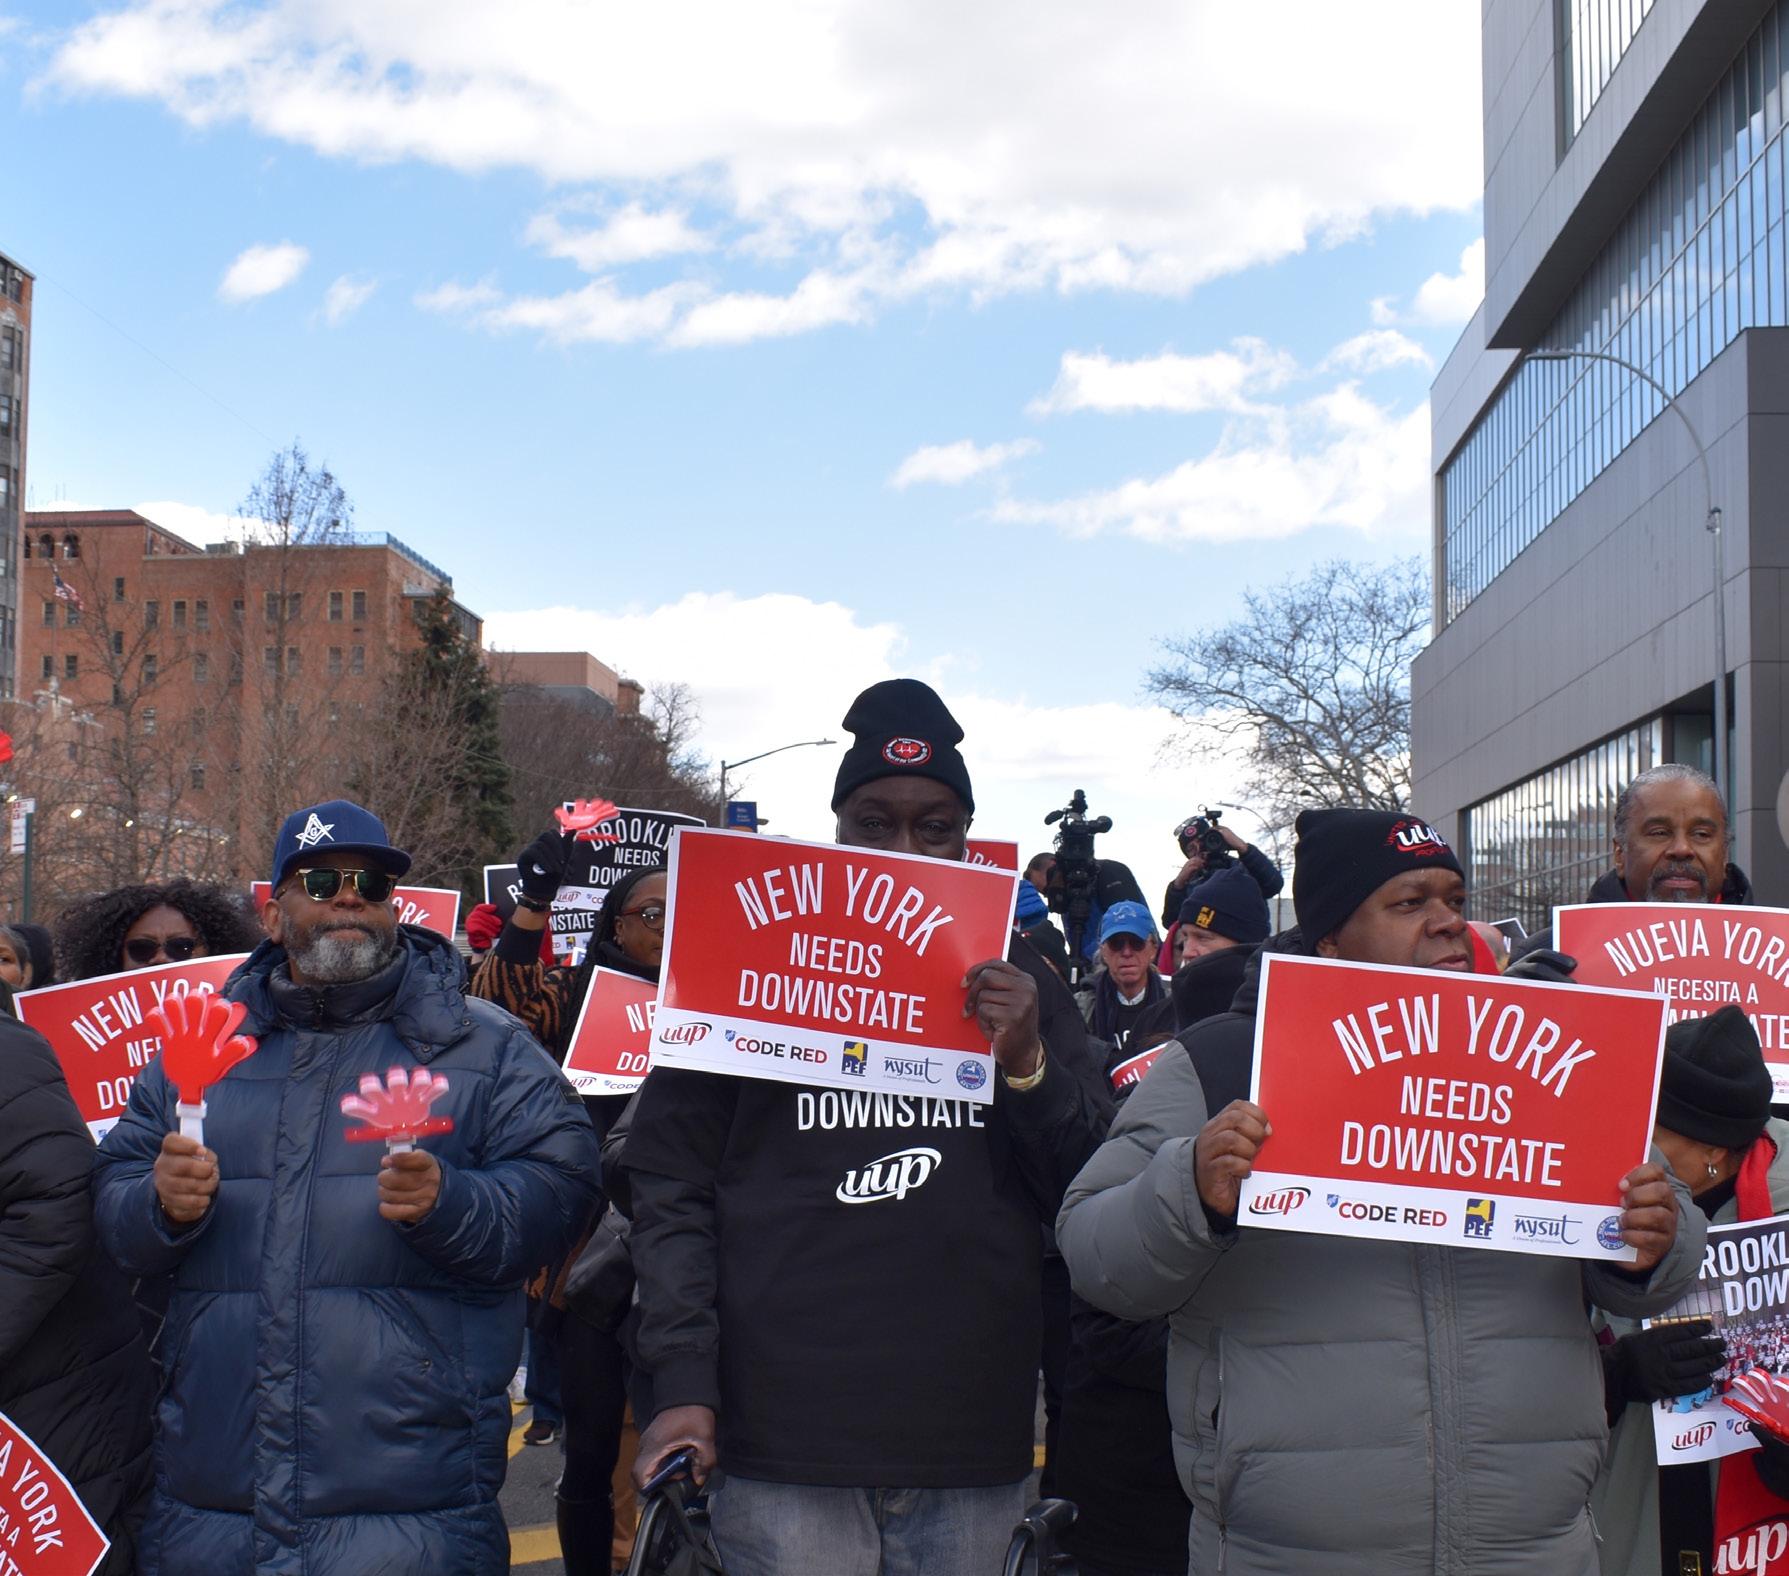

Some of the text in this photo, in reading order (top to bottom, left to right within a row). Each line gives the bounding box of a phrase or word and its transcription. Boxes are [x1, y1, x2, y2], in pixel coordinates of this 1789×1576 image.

[589, 866, 633, 887] DOW
[614, 847, 661, 867] NEEDS
[734, 863, 954, 957] NEW YORK
[789, 932, 883, 978] NEEDS
[1604, 918, 1710, 977] NUEVA
[71, 984, 145, 1052] NEW
[738, 969, 926, 1034] DOWNSTATE
[1654, 977, 1759, 1005] NECESITA A
[660, 1023, 711, 1046] uup
[735, 1037, 786, 1058] CODE
[790, 1045, 828, 1064] RED
[842, 1060, 867, 1075] PEF
[884, 1057, 943, 1084] nysut
[1332, 993, 1440, 1075] NEW
[1466, 995, 1597, 1098] YORK
[1400, 1076, 1513, 1125] NEEDS
[837, 1148, 942, 1204] uup
[1340, 1121, 1566, 1187] DOWNSTATE
[1250, 1188, 1310, 1215] uup
[1338, 1202, 1398, 1223] CODE
[1403, 1208, 1448, 1227] RED
[1464, 1221, 1493, 1236] PEF
[1515, 1215, 1582, 1245] nysut
[1672, 1422, 1716, 1450] uup
[12, 1458, 64, 1555] YORK
